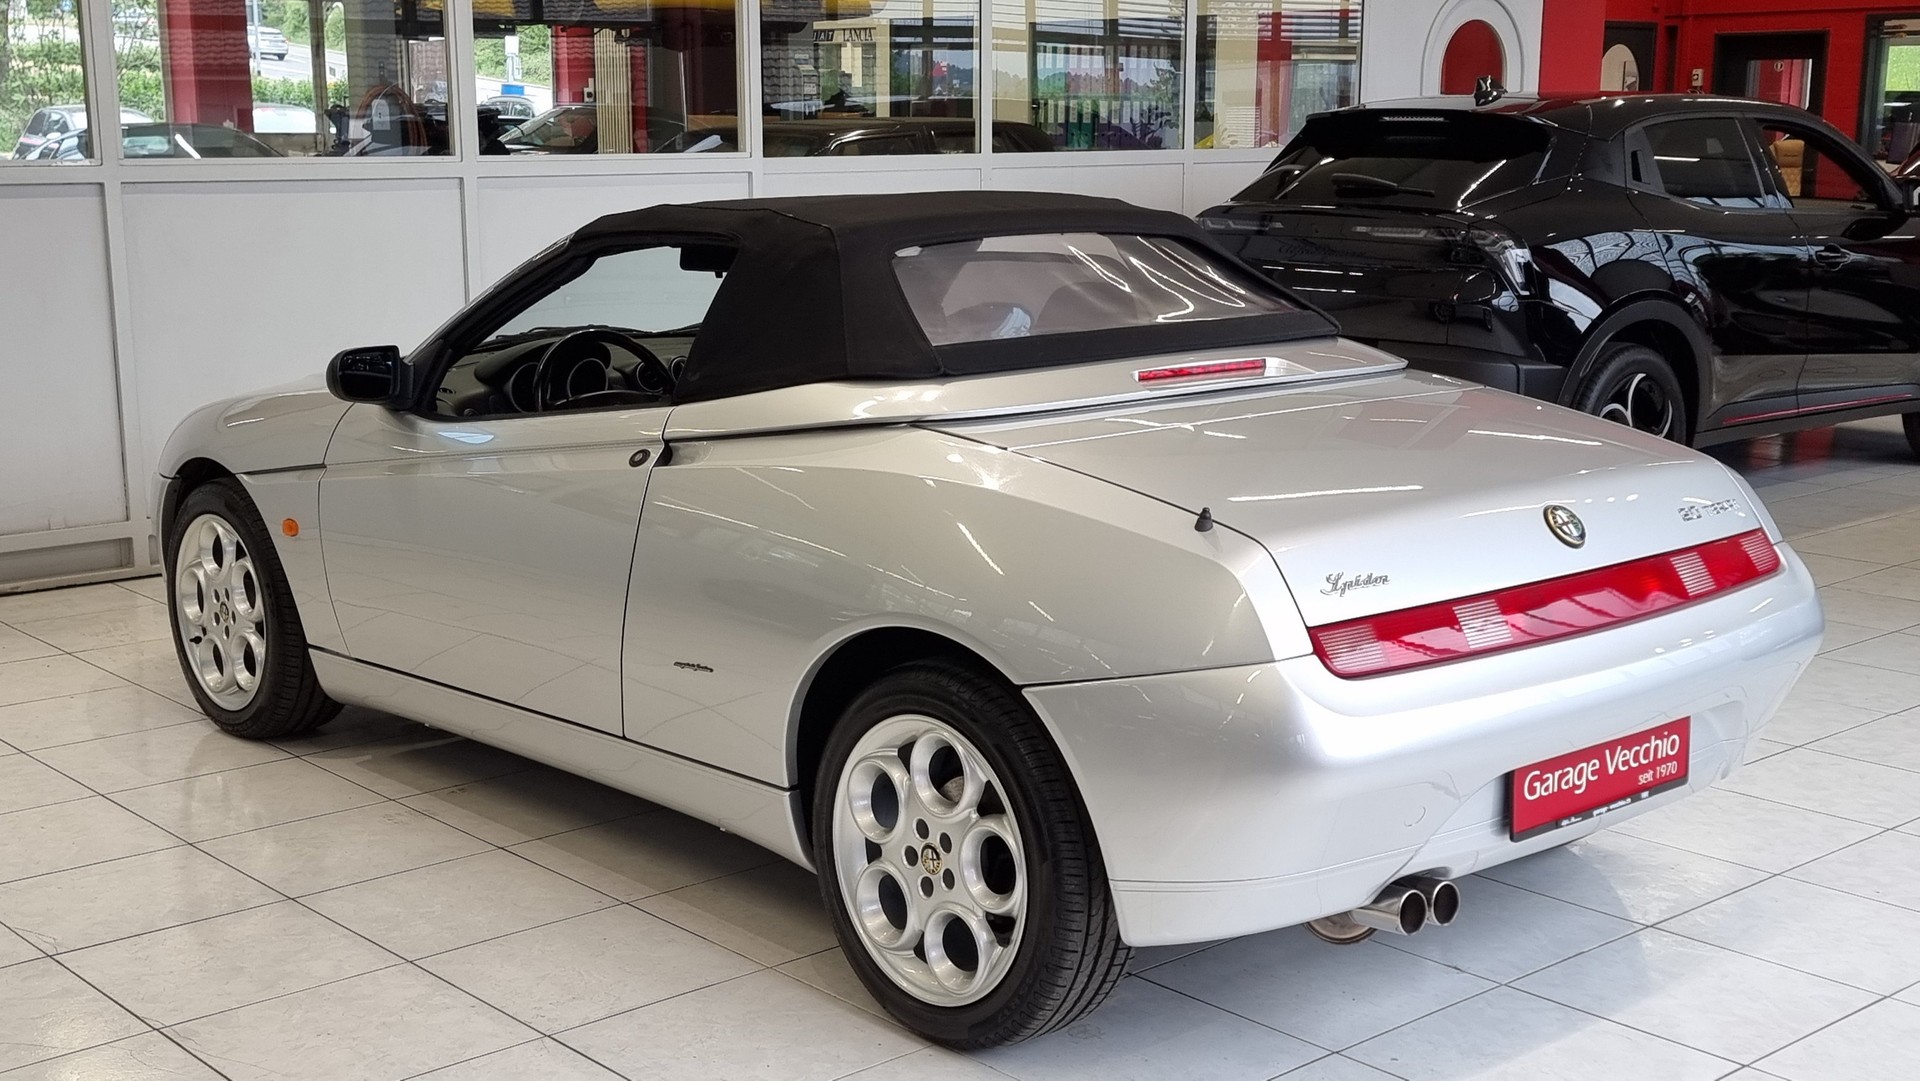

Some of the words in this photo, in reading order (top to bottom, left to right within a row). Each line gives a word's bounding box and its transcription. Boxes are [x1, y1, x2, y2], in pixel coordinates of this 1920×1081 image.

[813, 30, 834, 42] IAT
[842, 28, 874, 42] LANCIA
[1523, 758, 1600, 801] Garage
[1605, 731, 1680, 775] Vecchio
[1638, 769, 1654, 786] seit
[1656, 760, 1678, 780] 1970
